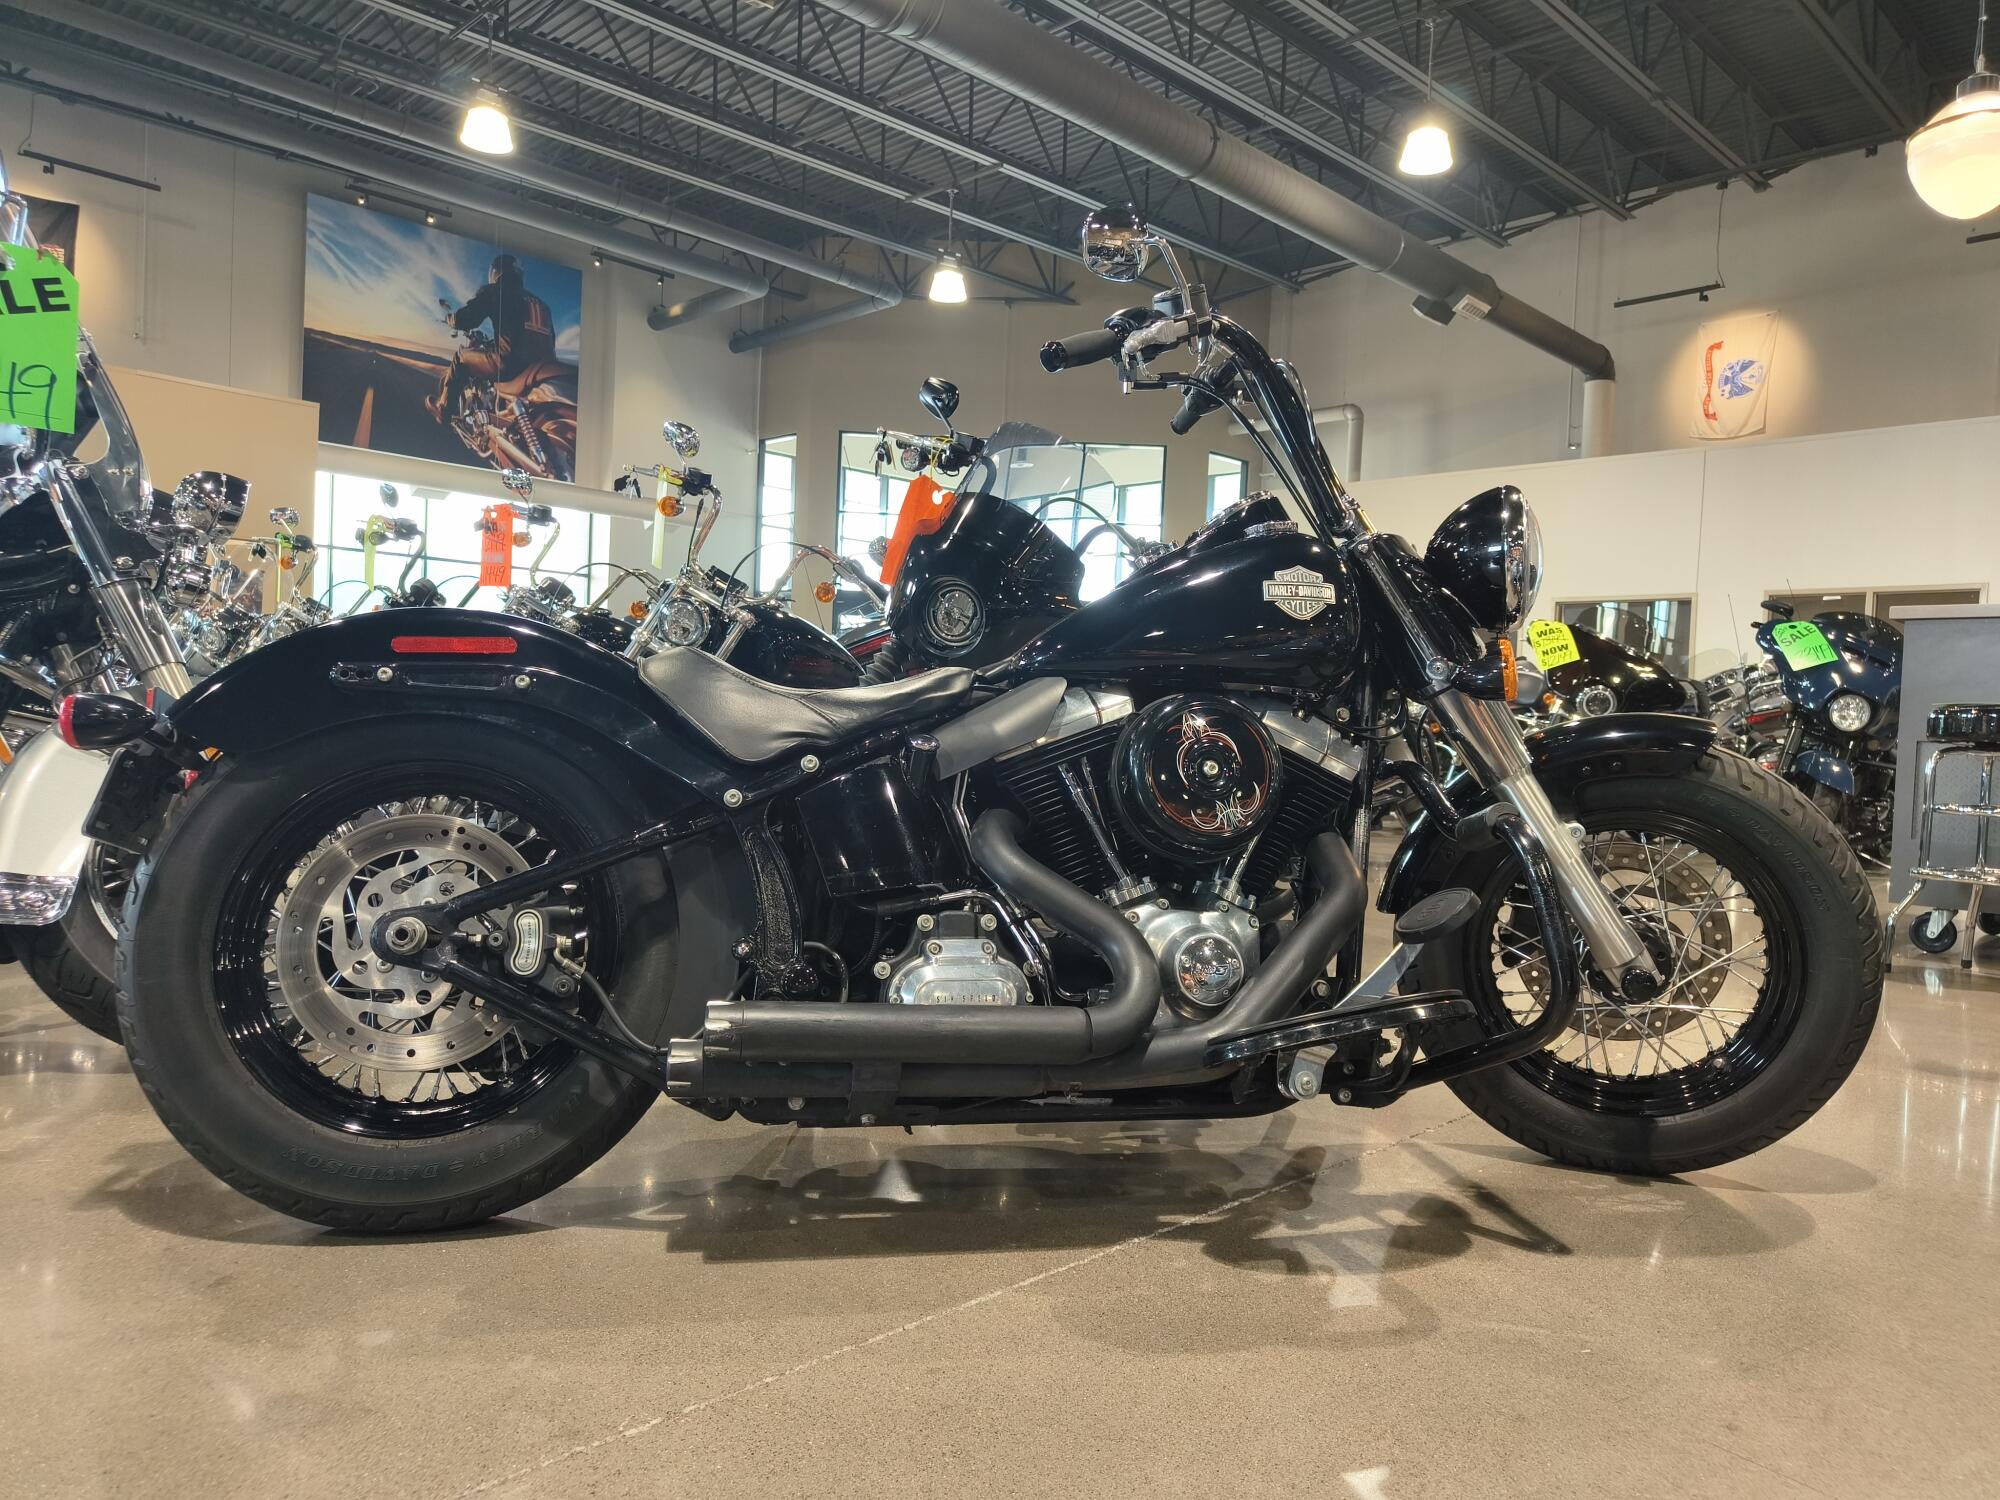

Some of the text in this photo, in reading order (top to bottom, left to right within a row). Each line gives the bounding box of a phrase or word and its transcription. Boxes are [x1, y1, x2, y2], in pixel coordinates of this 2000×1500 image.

[0, 277, 71, 315] LE
[1268, 584, 1332, 599] HARLEY-DAVIDSON
[1284, 600, 1318, 615] CYCLES
[1536, 627, 1563, 638] WAS
[1780, 625, 1817, 647] SALE
[1541, 643, 1569, 657] NOW
